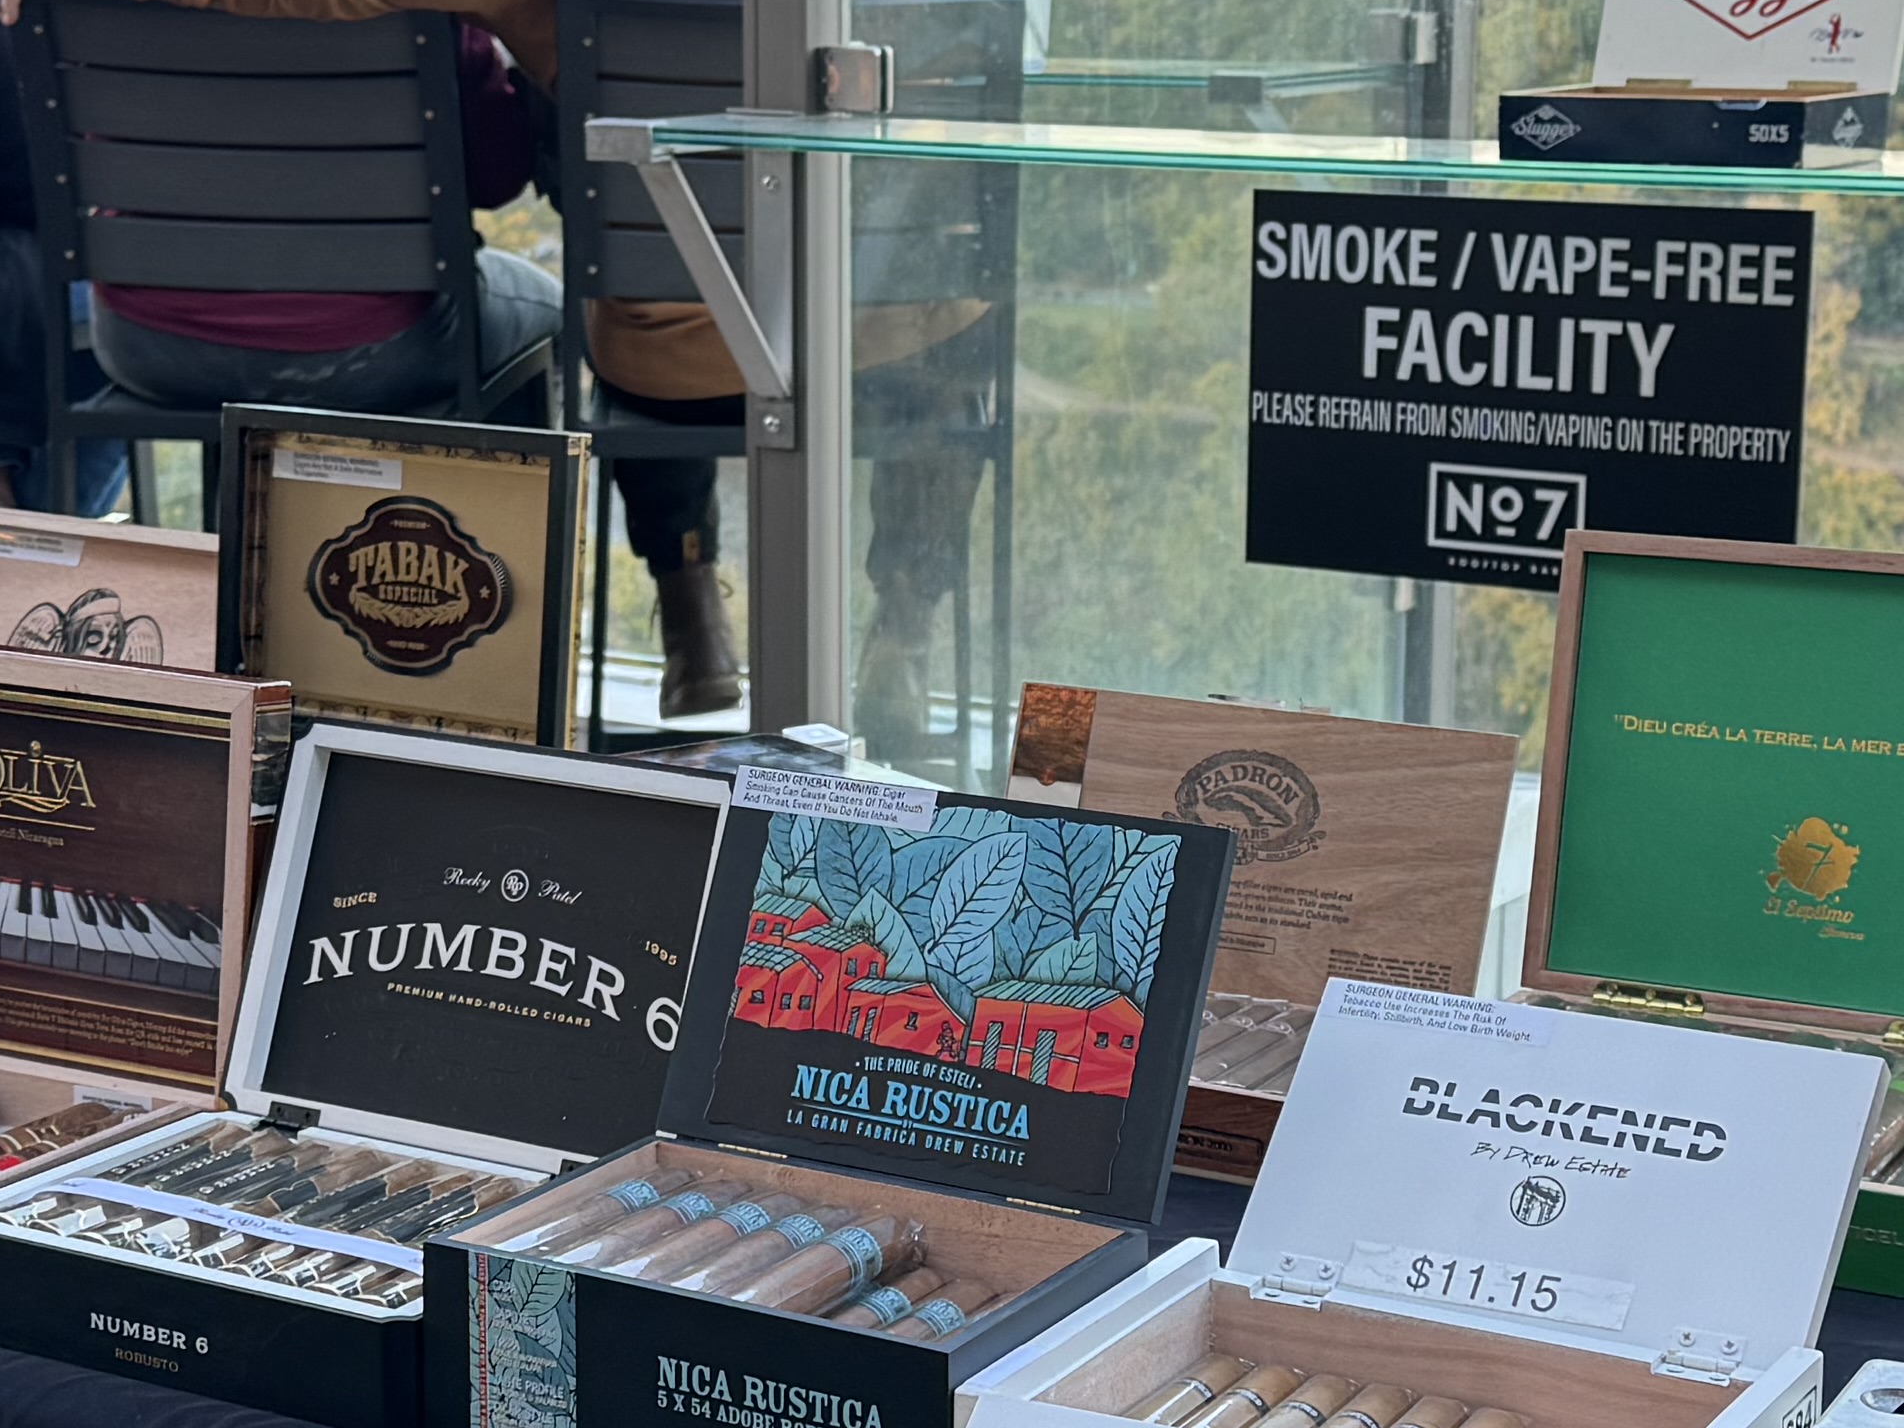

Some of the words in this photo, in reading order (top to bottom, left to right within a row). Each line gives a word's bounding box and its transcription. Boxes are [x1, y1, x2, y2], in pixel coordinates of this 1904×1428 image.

[1516, 112, 1577, 146] Slugger
[1256, 221, 1438, 288] SMOKE
[1452, 231, 1477, 291] /
[1490, 232, 1796, 307] VAPE-FREE
[1363, 307, 1675, 398] FACILITY
[1252, 391, 1314, 427] PLEASE
[1319, 395, 1392, 433] REFRAIN
[1396, 401, 1446, 438] FROM
[1450, 405, 1612, 450] SMOKING/VAPING
[1616, 418, 1644, 453] ON
[1646, 420, 1685, 456] THE
[1688, 423, 1791, 464] PROPERTY
[349, 541, 469, 598] TABAK
[378, 584, 439, 605] ESPECIAL
[1671, 720, 1720, 740] CRÉA
[1725, 726, 1748, 743] LA
[1752, 728, 1818, 751] TERRE,
[1822, 735, 1846, 752] LA
[1850, 738, 1892, 756] MER
[746, 780, 780, 796] Smoking
[748, 769, 791, 784] SURGEON
[792, 775, 832, 790] GENERAL
[333, 891, 377, 909] SINCE
[443, 867, 491, 893] Rocky
[539, 879, 583, 905] Patel
[643, 939, 677, 966] 1995
[303, 922, 626, 1022] NUMBER
[645, 997, 682, 1050] 6
[1345, 983, 1393, 999] SURGEON
[1395, 991, 1440, 1007] GENERAL
[1442, 998, 1496, 1014] WARNING:
[387, 982, 444, 1001] PREMIUM
[449, 993, 538, 1018] HAND-ROLLED
[543, 1010, 592, 1028] CIGARS
[1343, 994, 1381, 1010] Tobacco
[1383, 1002, 1402, 1013] Use
[1403, 1005, 1450, 1019] Increases
[1453, 1010, 1471, 1021] The
[1472, 1012, 1493, 1025] Risk
[1495, 1016, 1507, 1027] Of
[1426, 1018, 1446, 1029] And
[1448, 1021, 1468, 1033] Low
[1470, 1024, 1494, 1036] Birth
[864, 1057, 883, 1071] THE
[887, 1059, 919, 1076] PRIDE
[923, 1064, 936, 1077] OF
[939, 1066, 976, 1090] ESTELI
[790, 1064, 870, 1110] NICA
[881, 1080, 1030, 1140] RUSTICA
[1401, 1075, 1728, 1164] BLACKENED
[786, 1109, 803, 1125] LA
[811, 1114, 849, 1134] GRAN
[856, 1122, 917, 1146] FABRICA
[925, 1134, 964, 1155] DREW
[972, 1143, 1026, 1166] ESTATE
[1406, 1254, 1563, 1315] $11.15
[90, 1312, 187, 1351] NUMBER
[195, 1336, 209, 1355] 6
[115, 1347, 179, 1373] ROBUSTO
[657, 1356, 730, 1401] NICA
[657, 1390, 667, 1410] 5
[673, 1393, 685, 1414] X
[691, 1398, 712, 1420] 54
